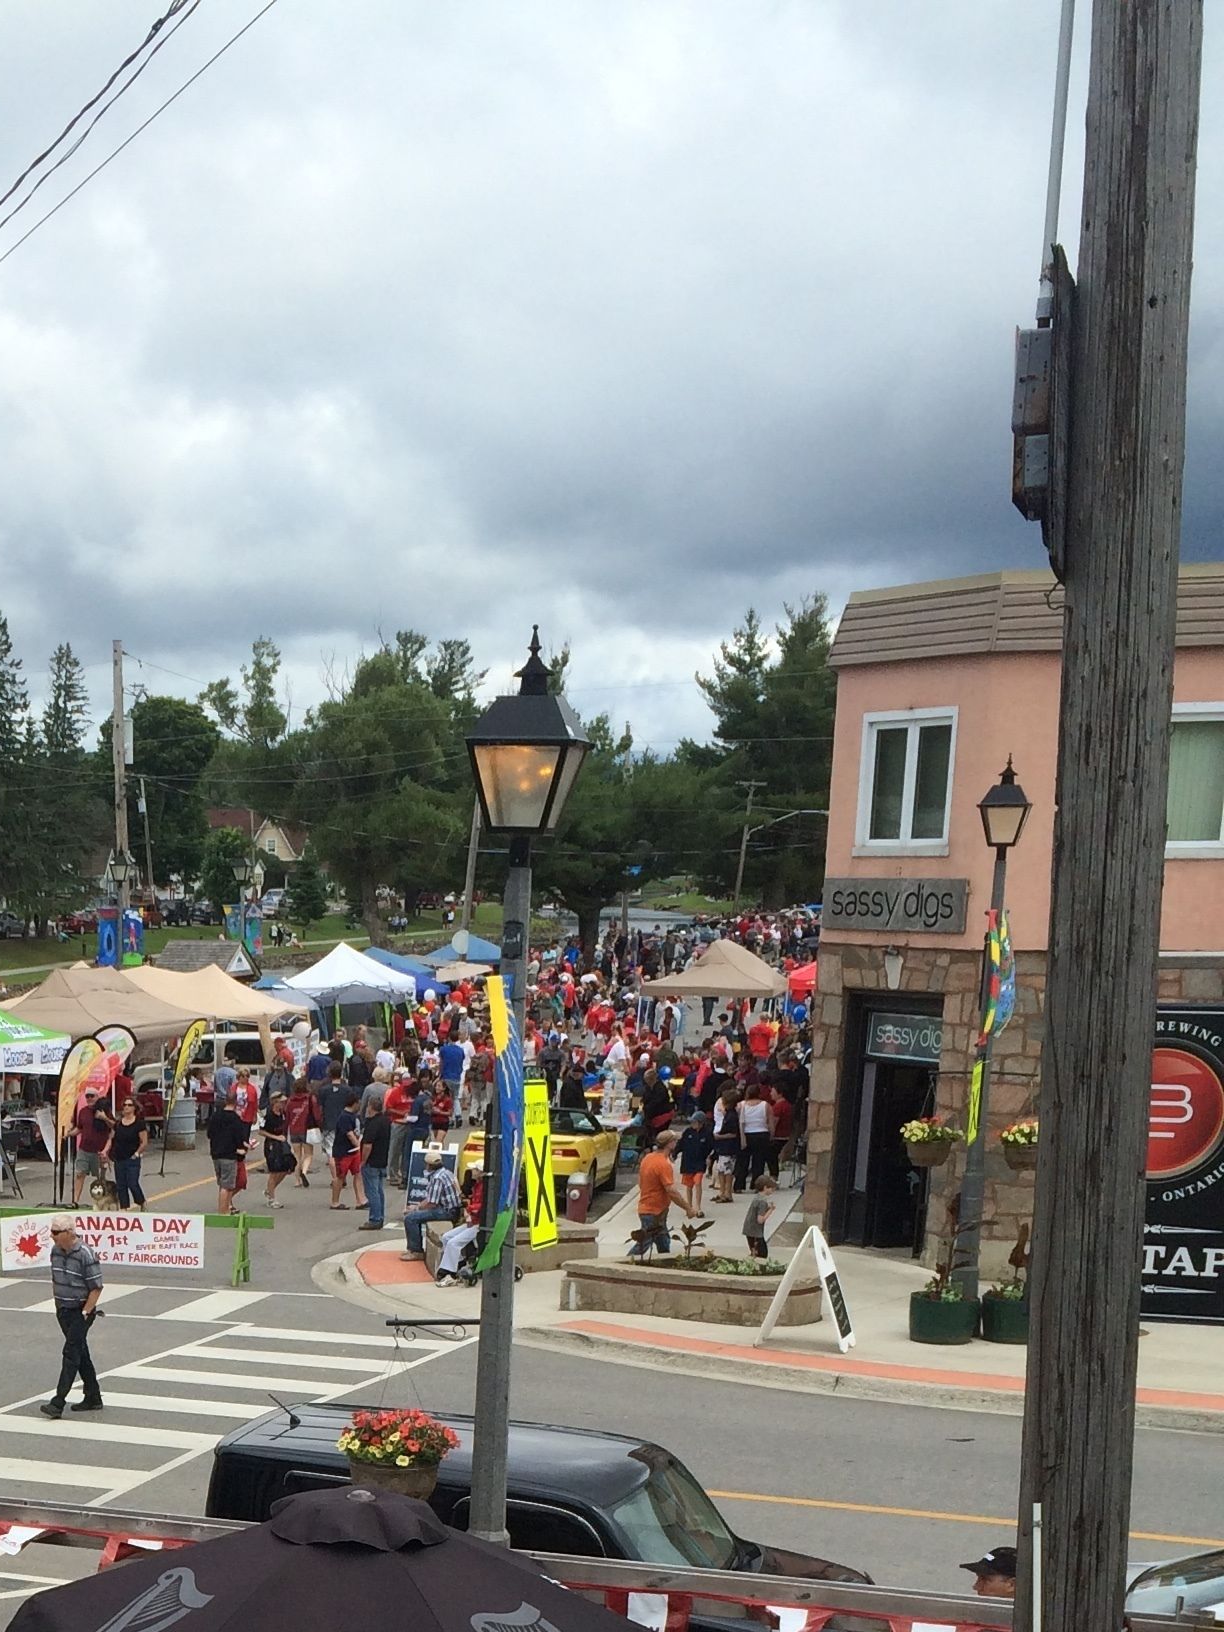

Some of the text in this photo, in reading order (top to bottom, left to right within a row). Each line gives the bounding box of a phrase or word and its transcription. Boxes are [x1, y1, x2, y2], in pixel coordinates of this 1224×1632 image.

[831, 882, 954, 928] sassy digs
[875, 1023, 943, 1053] sassy dig
[1156, 1020, 1222, 1047] REWING
[75, 1215, 191, 1235] ANADA DAY
[107, 1234, 128, 1248] 1st
[112, 1252, 125, 1262] AT
[128, 1252, 199, 1266] FAIRGROUNDS
